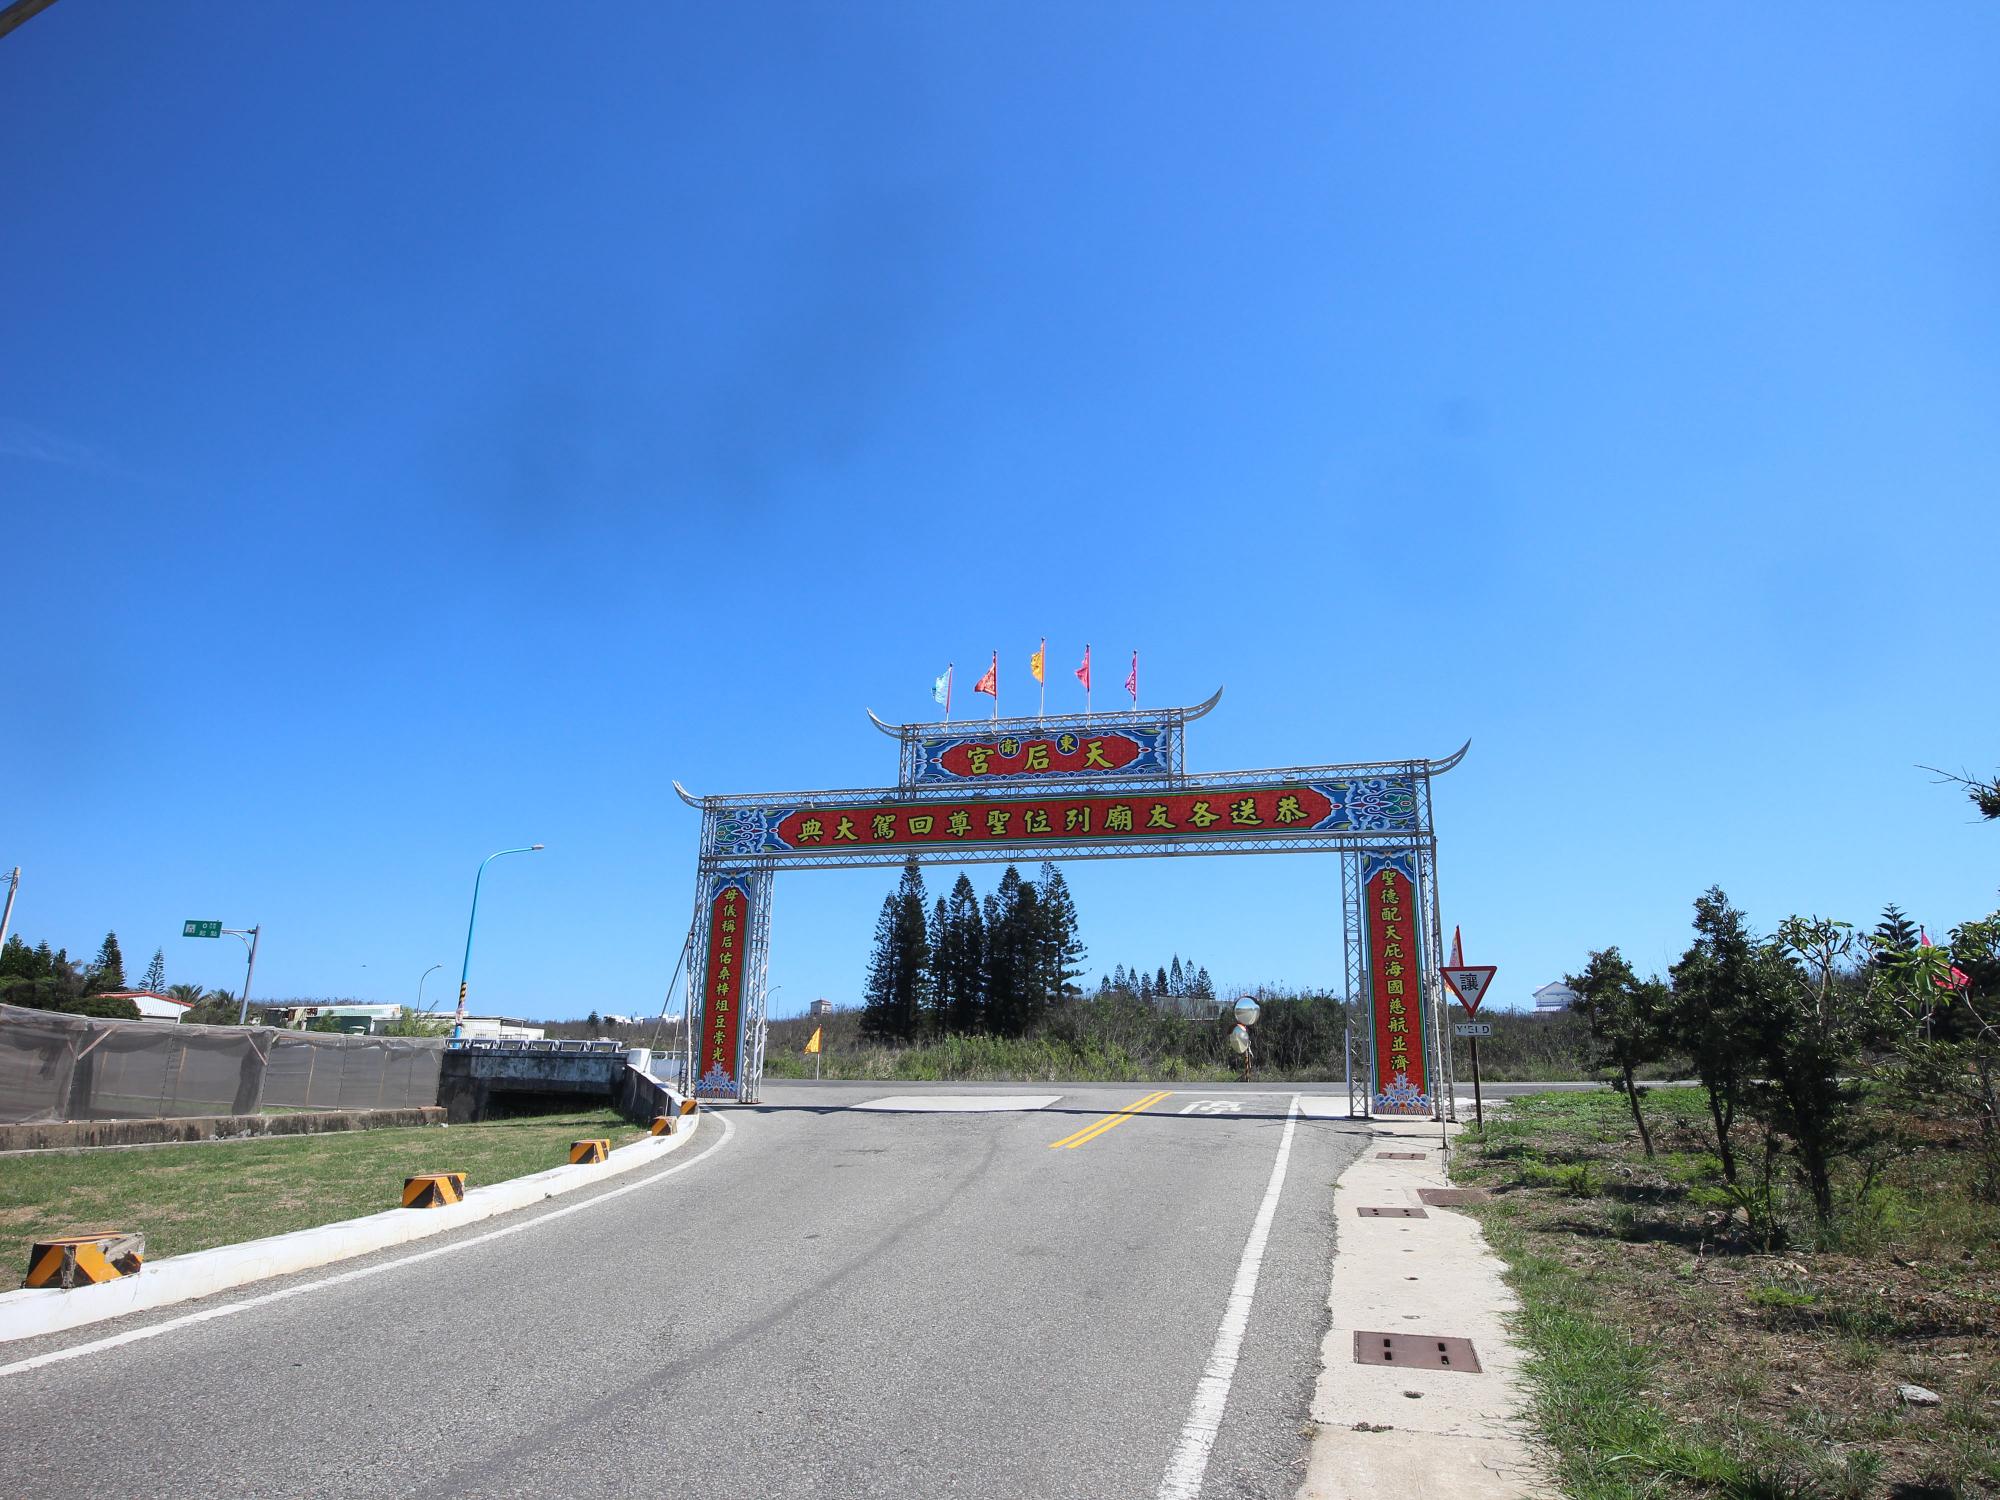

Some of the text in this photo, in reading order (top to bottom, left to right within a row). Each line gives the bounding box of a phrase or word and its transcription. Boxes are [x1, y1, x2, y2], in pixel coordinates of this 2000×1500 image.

[967, 741, 1115, 775] 天后宮
[1460, 973, 1479, 991] 讓
